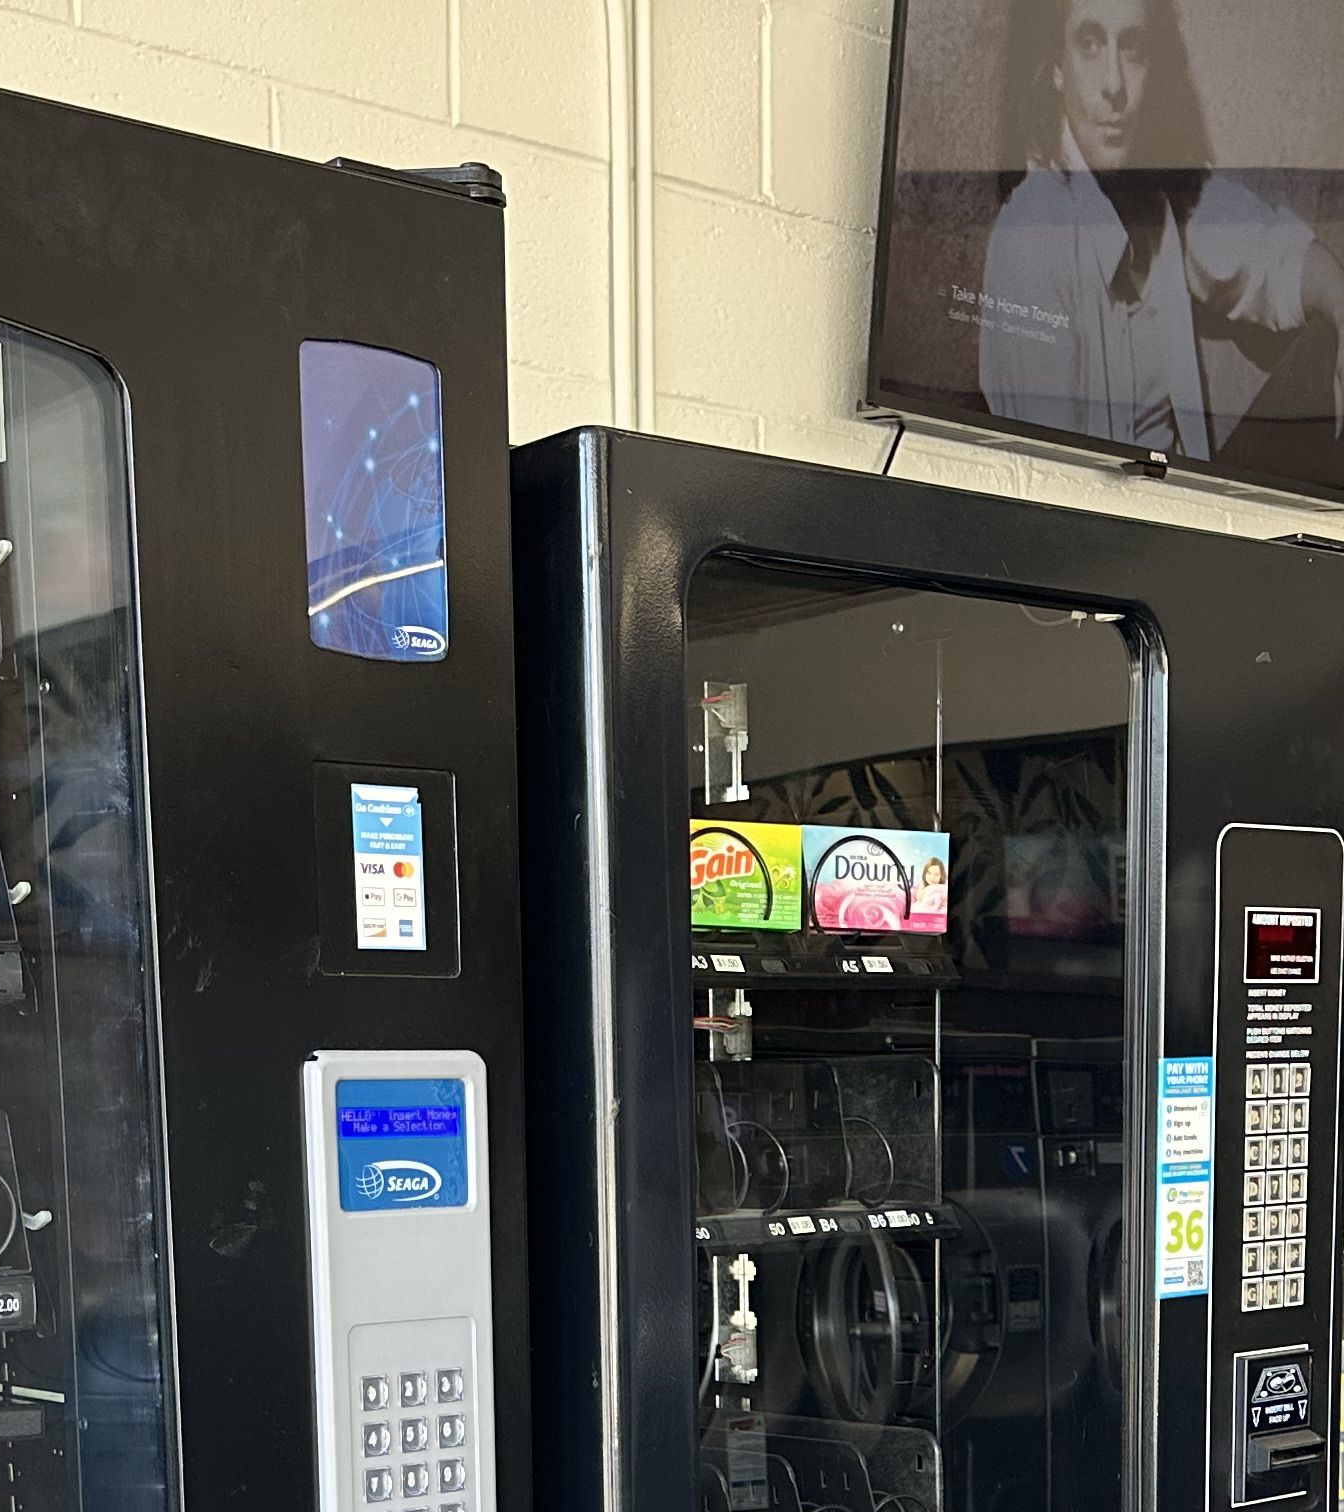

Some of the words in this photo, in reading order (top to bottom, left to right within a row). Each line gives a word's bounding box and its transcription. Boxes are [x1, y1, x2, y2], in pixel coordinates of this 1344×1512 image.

[951, 284, 976, 305] Take
[978, 291, 995, 309] Me
[997, 297, 1029, 318] Home
[1031, 304, 1070, 329] Tonight
[411, 636, 439, 651] SEAGA
[360, 862, 386, 875] VISA
[834, 854, 915, 892] Downy
[842, 960, 860, 973] A5
[1166, 1062, 1184, 1075] PAY
[1185, 1061, 1209, 1075] WITH
[387, 1174, 429, 1193] SEAGA
[1166, 1209, 1205, 1254] 36
